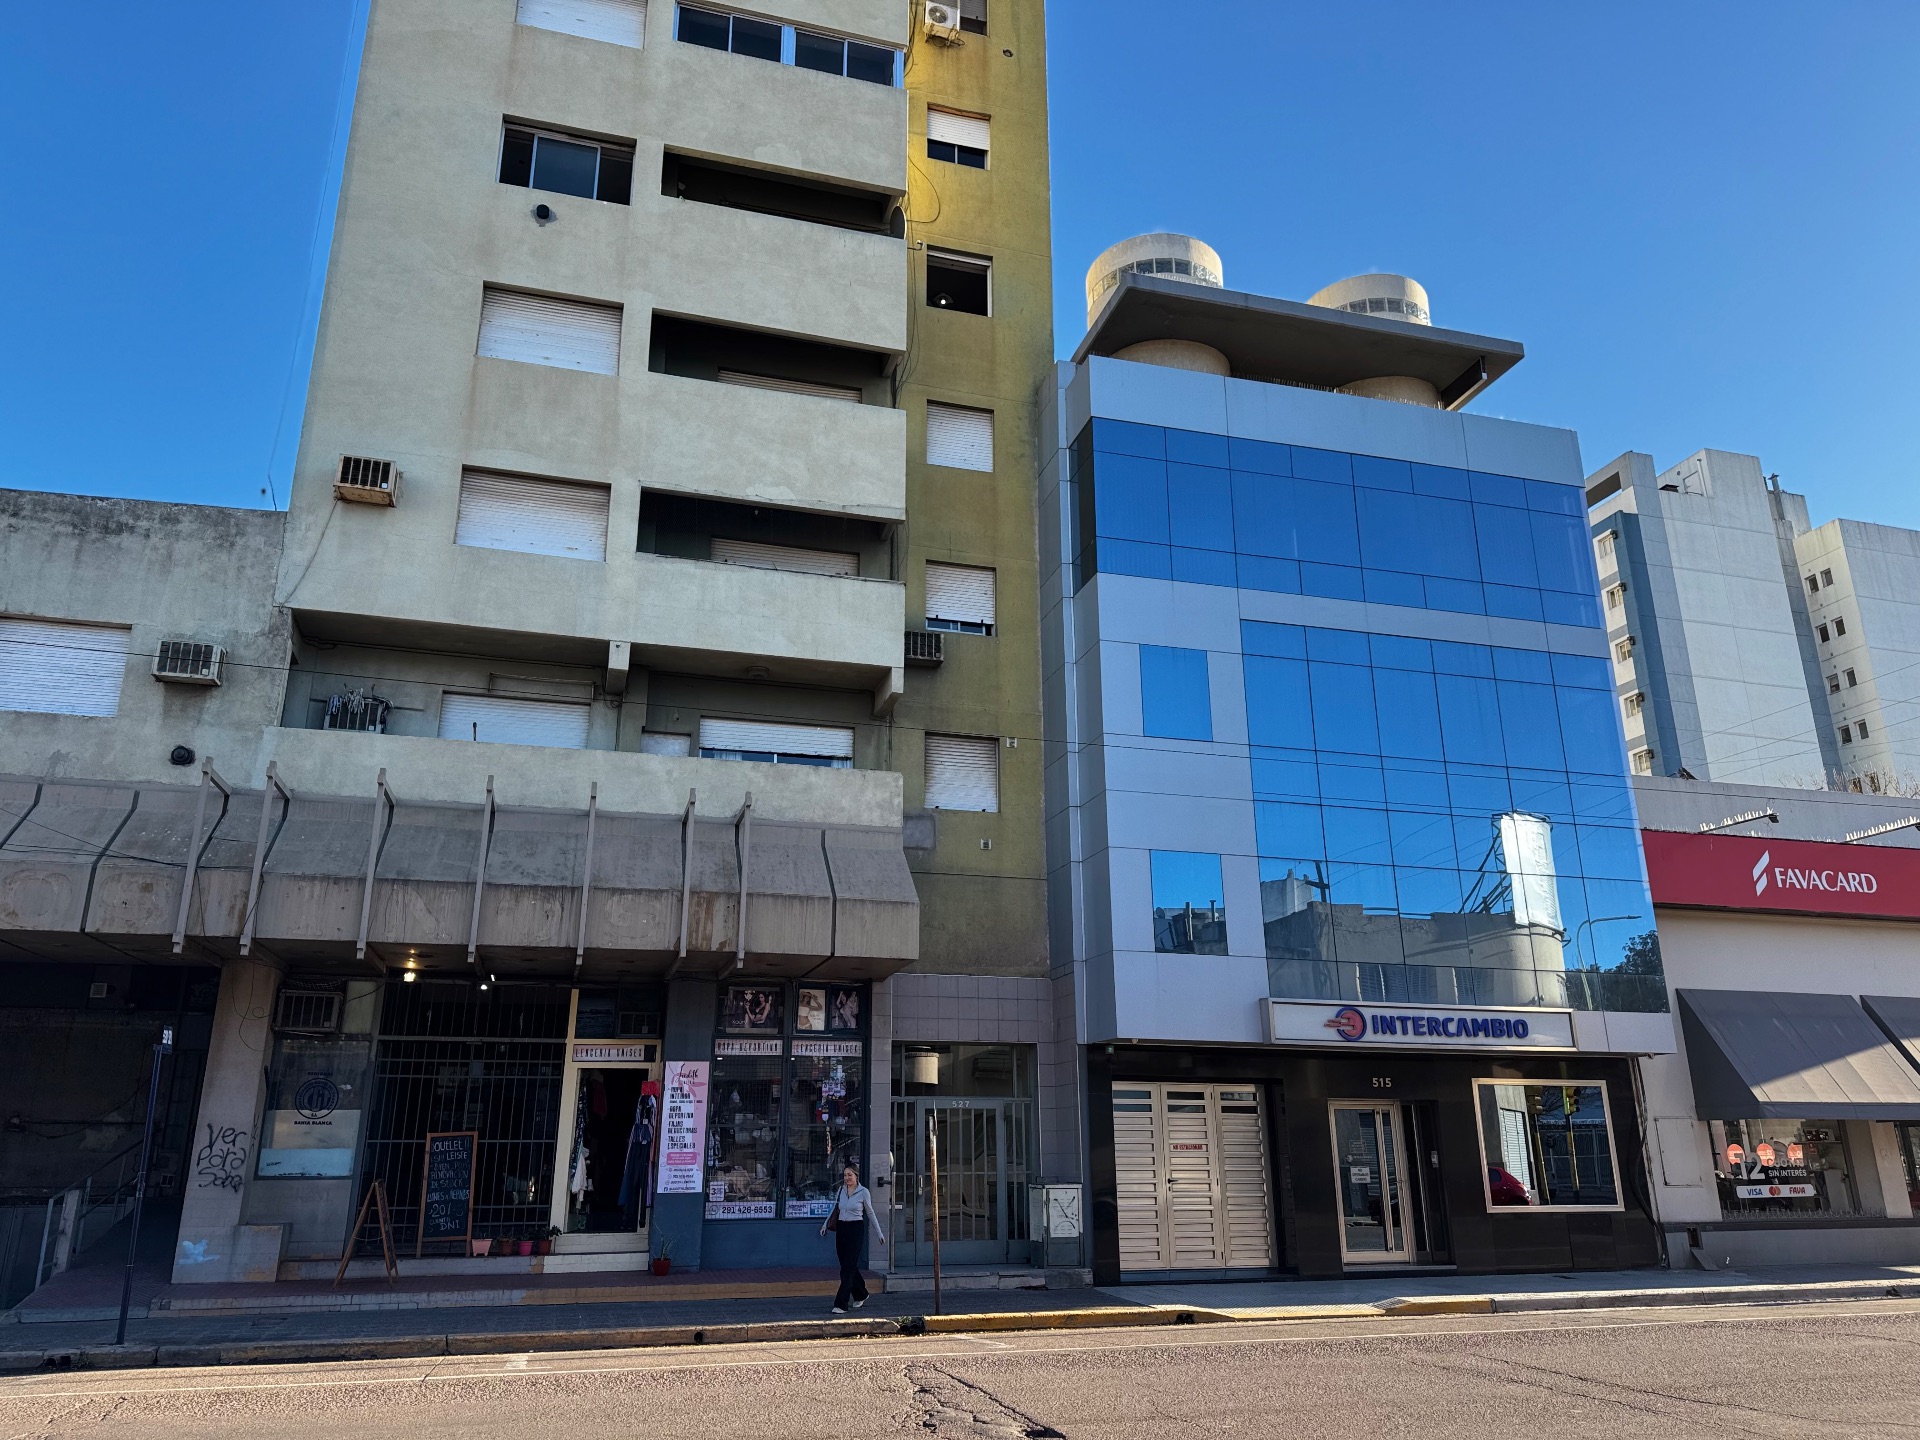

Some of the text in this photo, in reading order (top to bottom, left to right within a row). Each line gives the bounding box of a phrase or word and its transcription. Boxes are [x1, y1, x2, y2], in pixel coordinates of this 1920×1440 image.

[1774, 867, 1878, 894] FAVACARD
[1371, 1014, 1529, 1039] INTERCAMBIO
[1372, 1077, 1392, 1088] 515
[952, 1100, 970, 1108] 527
[1734, 1152, 1766, 1180] 12
[1746, 1186, 1806, 1196] VISA FAVA
[721, 1206, 736, 1214] 291
